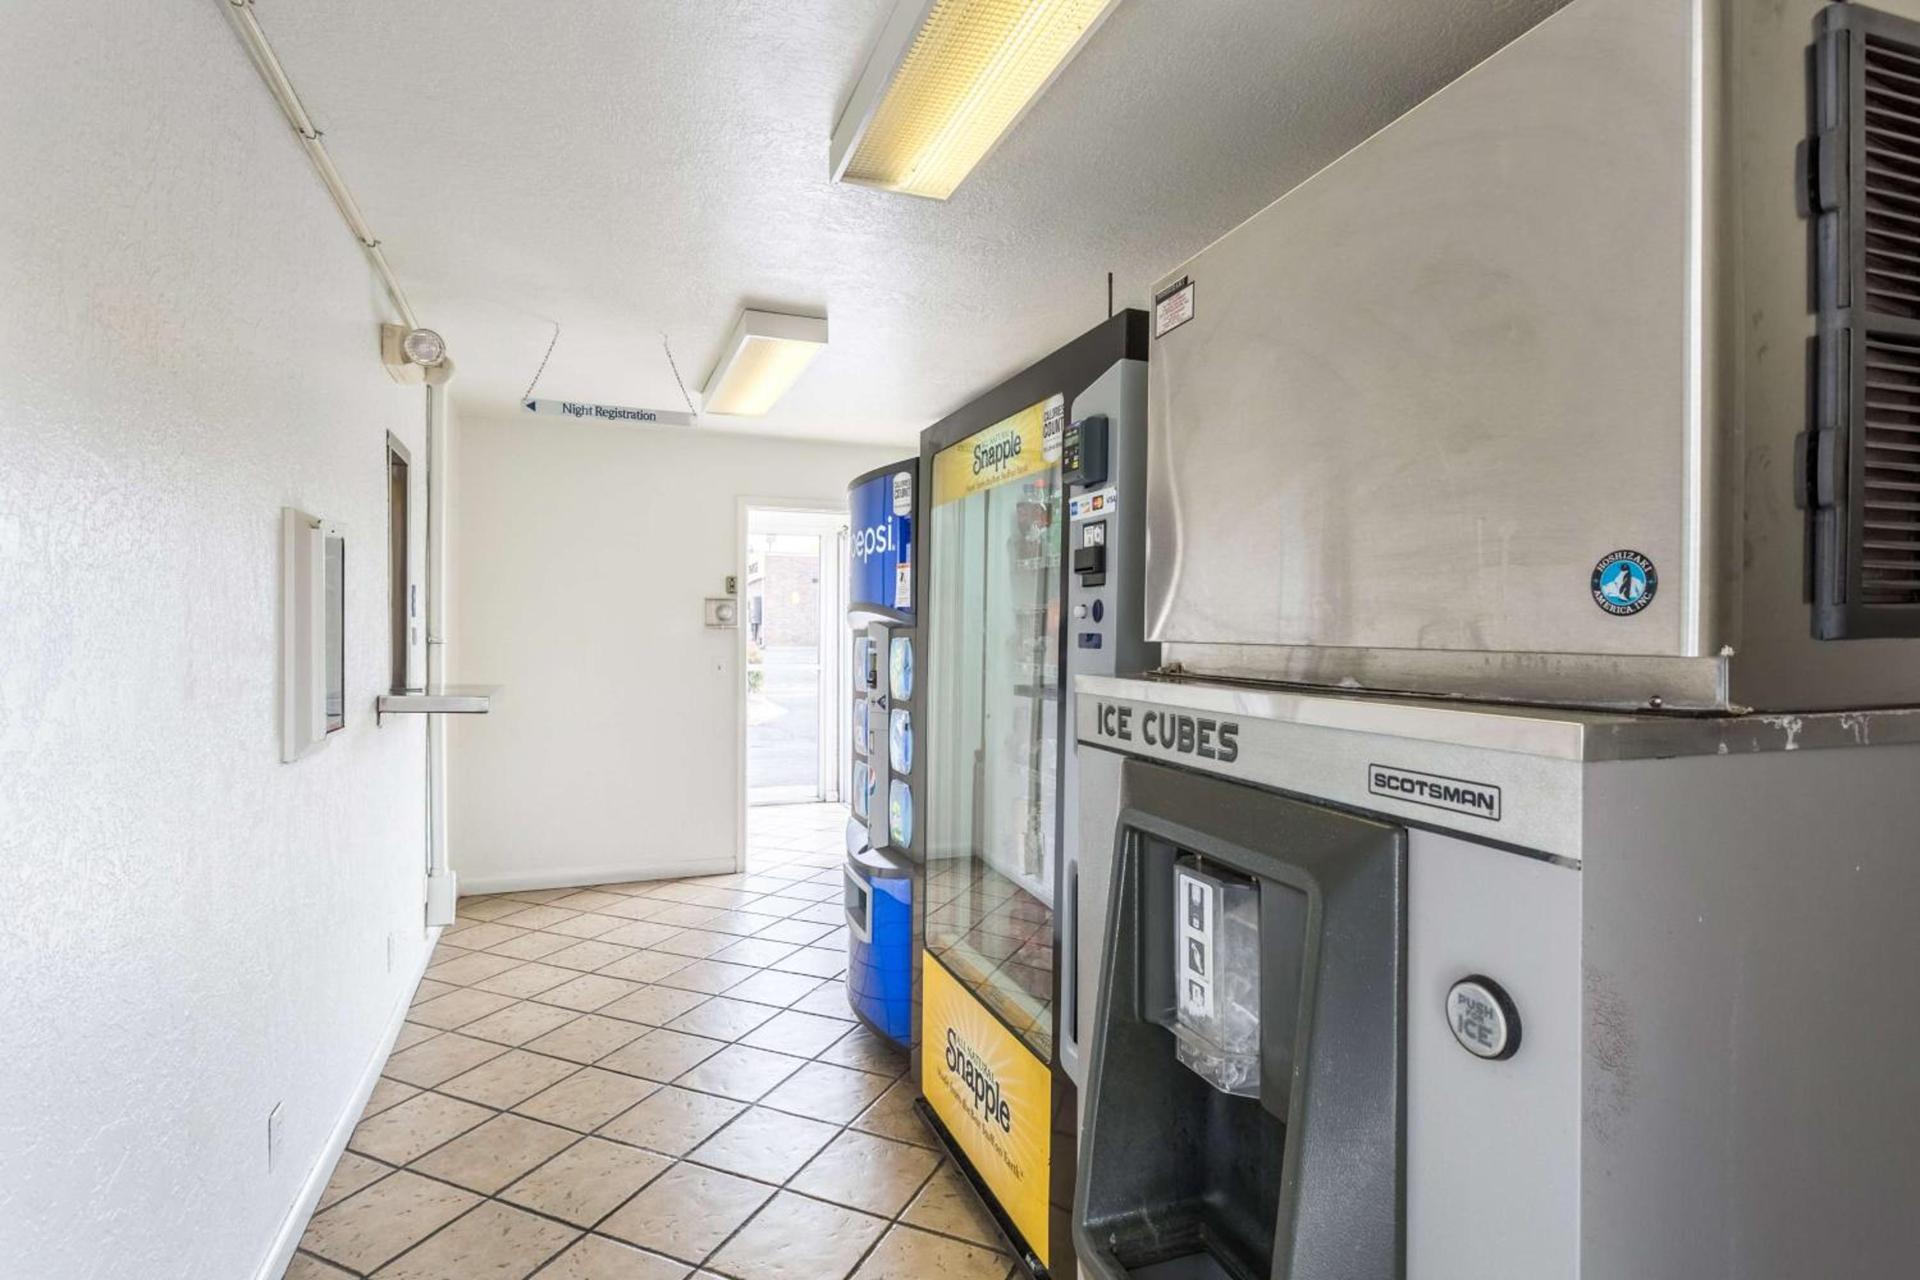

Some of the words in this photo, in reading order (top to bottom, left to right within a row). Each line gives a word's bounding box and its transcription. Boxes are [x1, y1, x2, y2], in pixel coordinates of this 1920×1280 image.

[562, 402, 594, 418] Night
[595, 406, 657, 421] Registration
[973, 430, 1021, 475] Snapple
[1597, 551, 1652, 573] HOSHIZAKI
[1097, 702, 1132, 740] ICE
[1142, 710, 1239, 762] CUBES
[1373, 772, 1494, 811] SCOTSMAN
[1458, 993, 1493, 1020] PUSH
[1458, 1014, 1493, 1048] ICE
[946, 1027, 1010, 1133] Snapple
